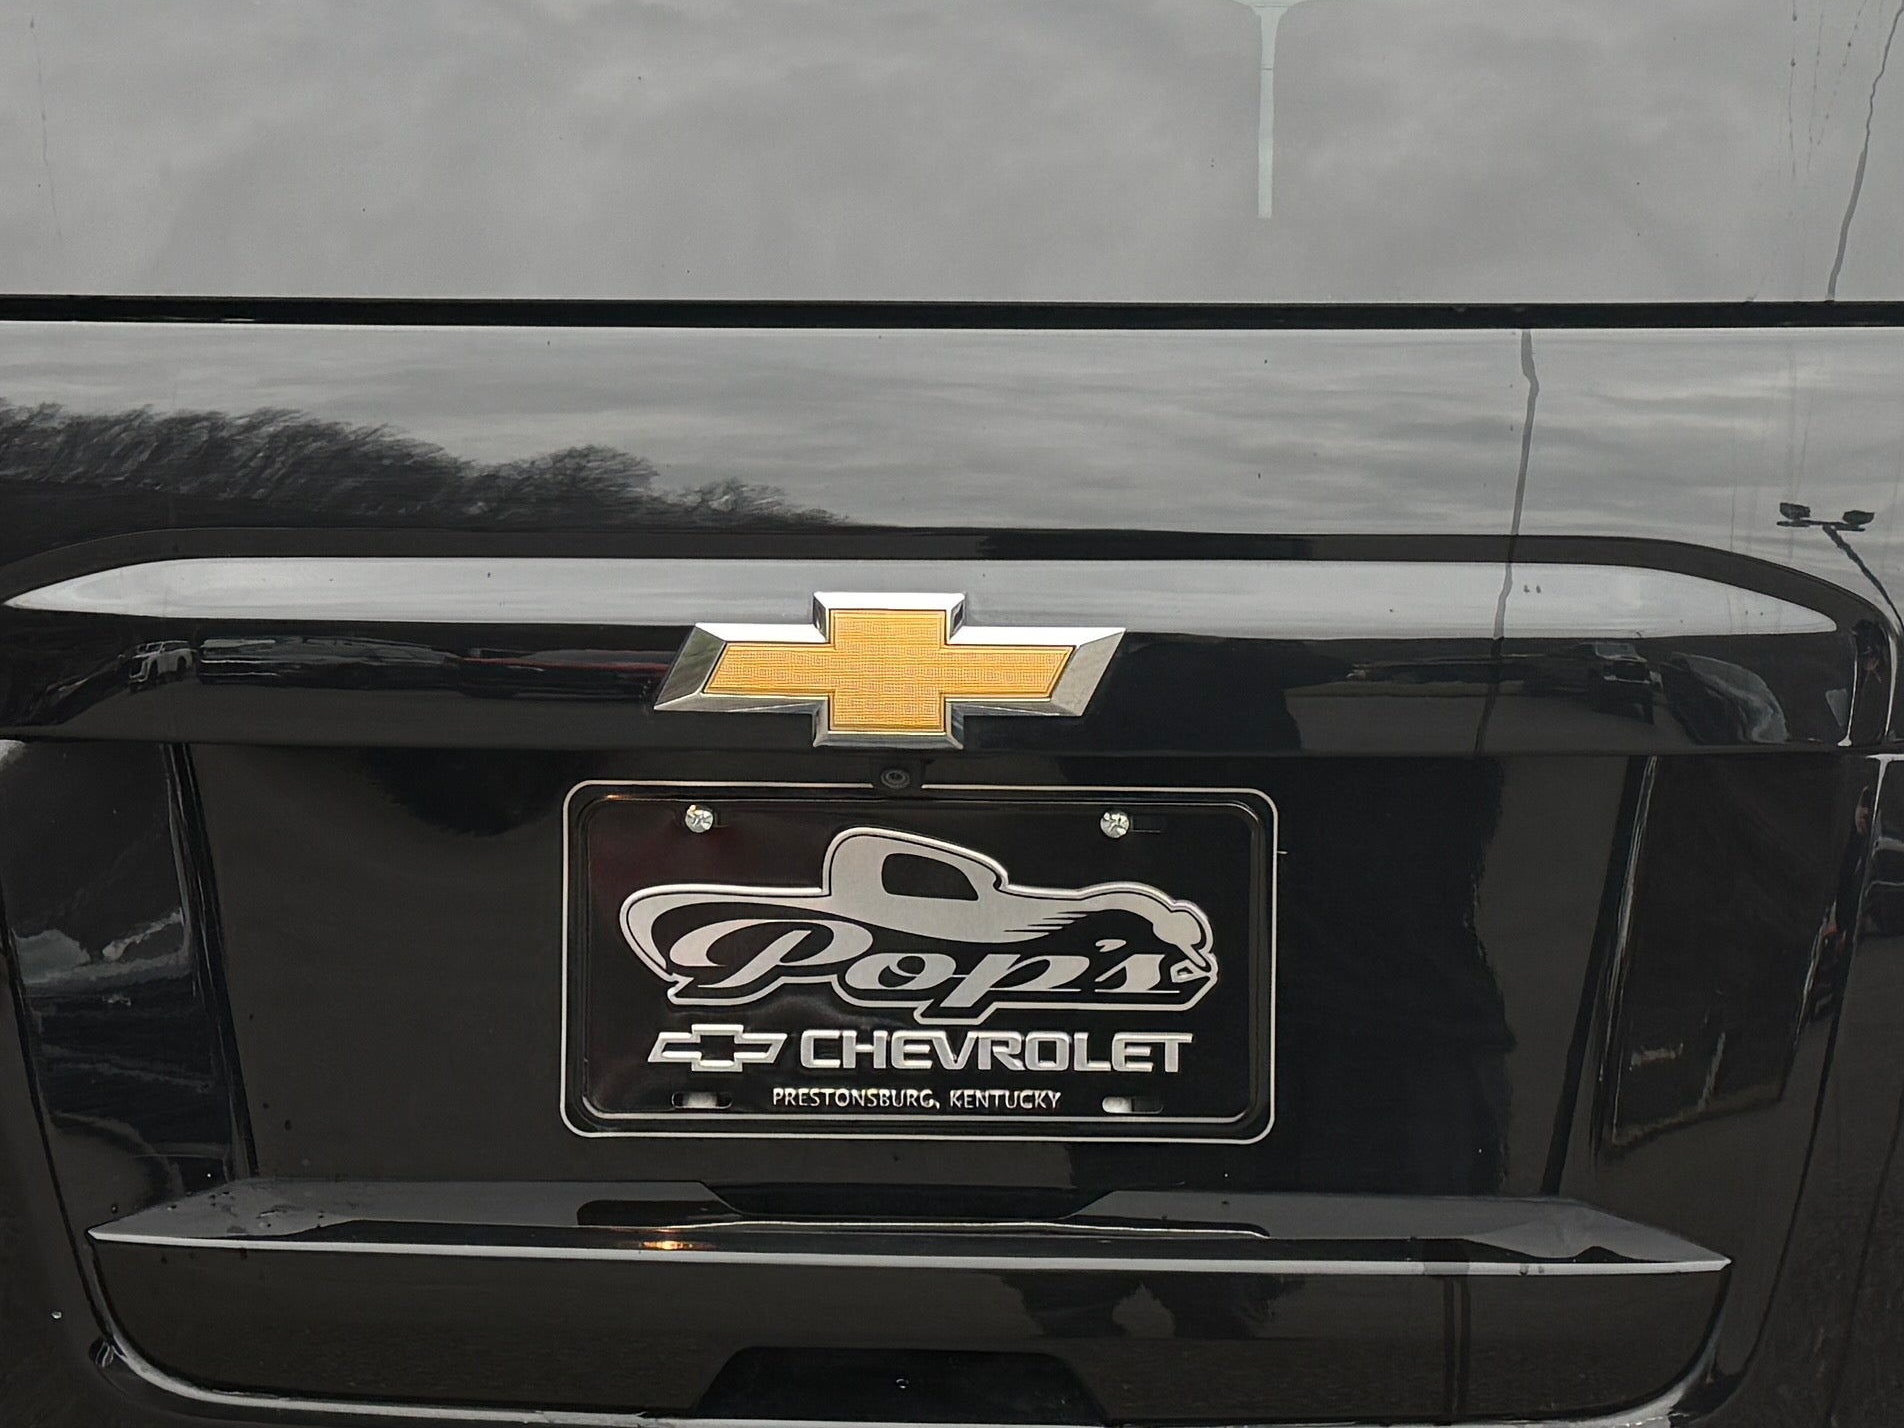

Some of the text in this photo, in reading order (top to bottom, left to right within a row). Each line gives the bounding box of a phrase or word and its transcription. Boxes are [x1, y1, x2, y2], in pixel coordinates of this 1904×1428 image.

[669, 917, 1181, 1008] Pop's
[799, 1028, 1194, 1073] CHEVROLET
[771, 1086, 1062, 1110] PRESTONSBURG, KENTUCKY
